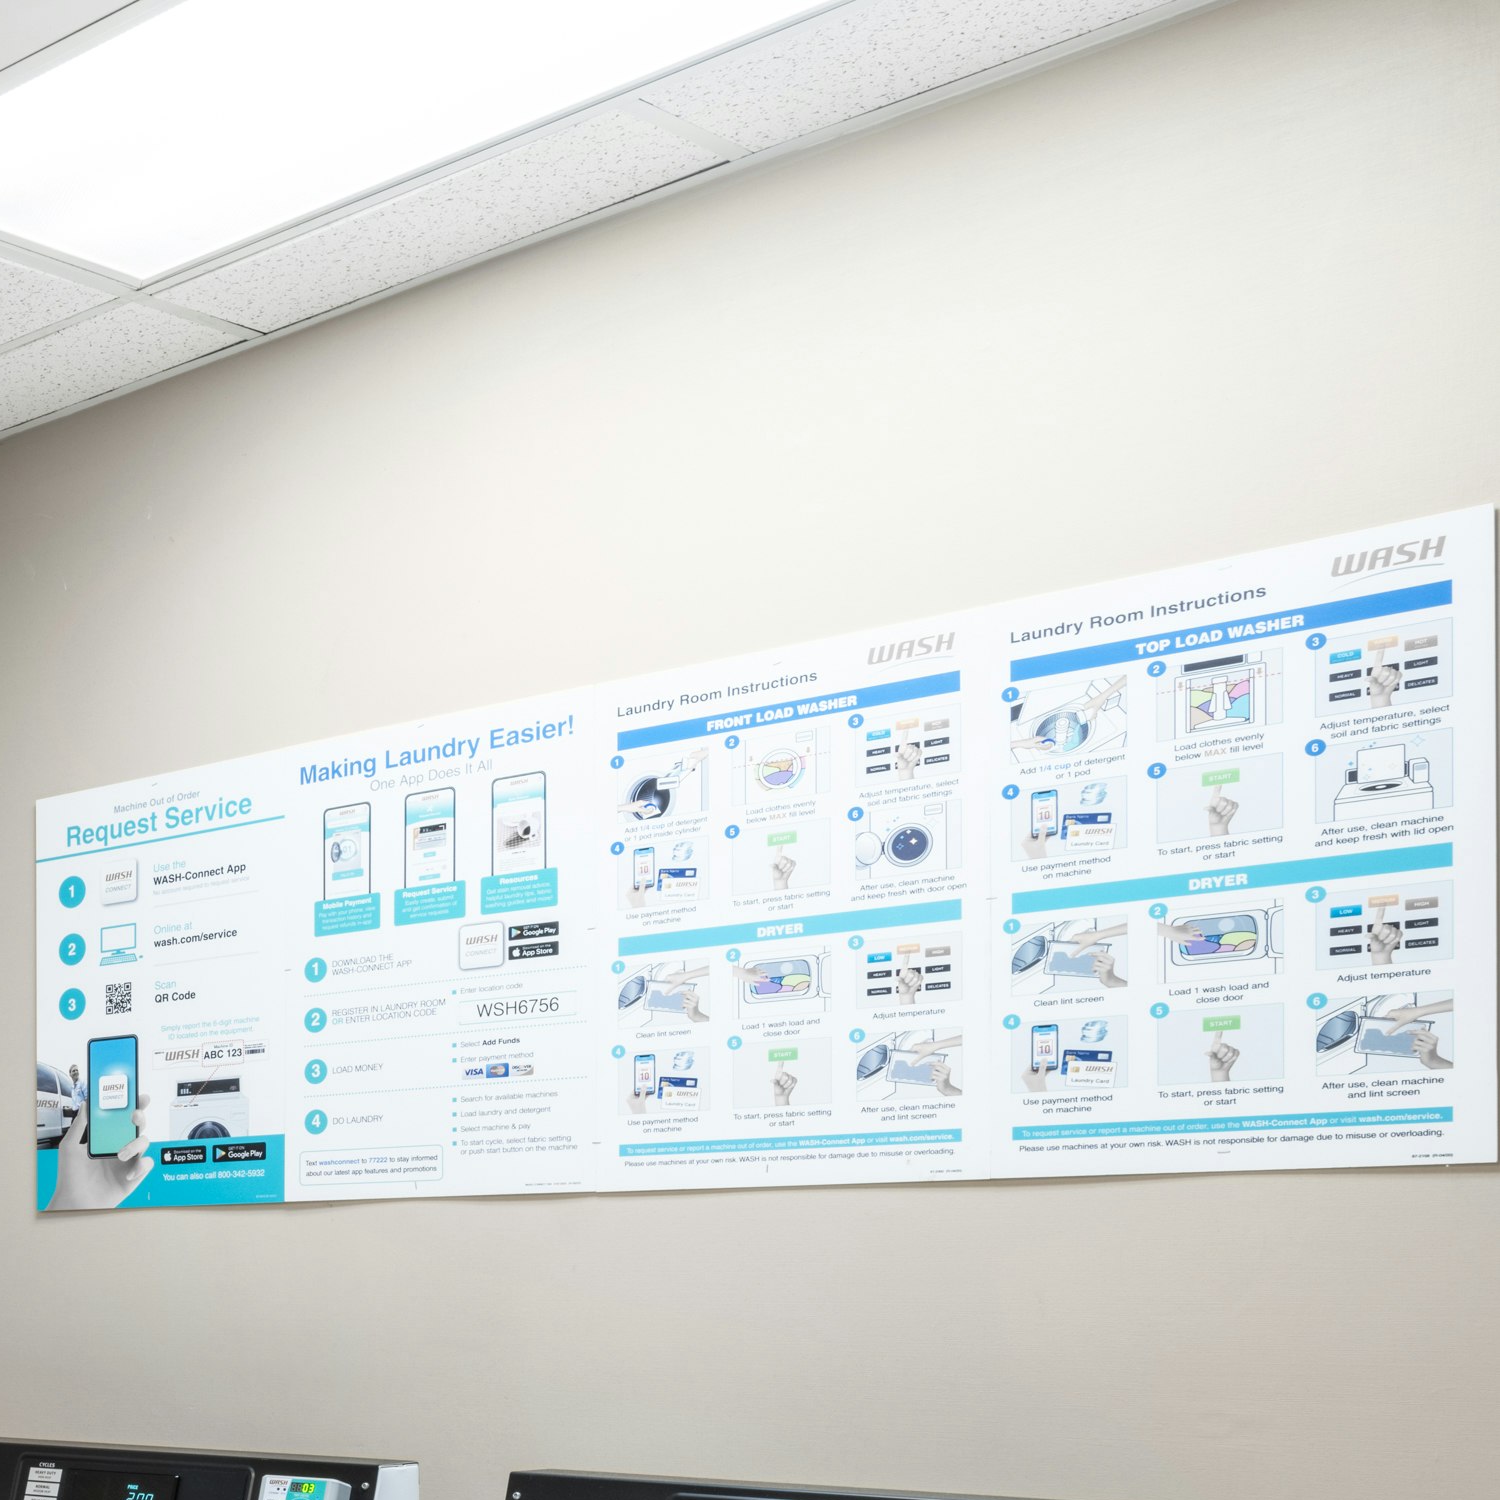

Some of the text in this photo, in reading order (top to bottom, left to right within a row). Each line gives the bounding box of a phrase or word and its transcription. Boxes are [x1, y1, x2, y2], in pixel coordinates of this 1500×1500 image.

[1330, 536, 1446, 577] WASH
[1010, 586, 1267, 643] Laundry Room Instructions
[1135, 614, 1305, 655] TOP LOAD WASHER
[867, 632, 956, 665] WASH
[616, 671, 818, 717] Laundry Room Instructions
[706, 695, 857, 732] FRONT LOAD WASHER
[300, 714, 574, 786] Making Laundry Easier!
[370, 759, 492, 792] One App Does It All
[113, 790, 200, 814] Machine Out of Order
[66, 797, 253, 847] Request Service
[105, 870, 133, 882] WASH
[153, 866, 224, 886] WASH-Connect
[227, 863, 246, 874] App
[1188, 873, 1248, 891] DRYER
[68, 885, 75, 898] 1
[154, 922, 192, 934] Online at
[757, 923, 804, 938] DRYER
[153, 928, 238, 948] wash.com/service
[68, 943, 76, 956] 2
[1337, 968, 1431, 982] Adjust temperature
[154, 979, 176, 990] Scan
[154, 990, 196, 1004] QR Code
[68, 999, 76, 1011] 3
[476, 997, 560, 1018] WSH6756
[482, 1037, 520, 1046] Add Funds
[164, 1049, 200, 1062] WASH
[203, 1048, 242, 1060] ABC 123
[464, 1068, 484, 1077] VISA
[1322, 1082, 1345, 1090] After
[1401, 1077, 1444, 1085] machine
[173, 1150, 203, 1162] App Store
[227, 1148, 263, 1159] Google Play
[163, 1173, 175, 1181] You
[190, 1172, 204, 1180] also
[205, 1171, 216, 1179] call
[217, 1169, 265, 1178] 800-342-5932
[302, 1483, 315, 1493] 03
